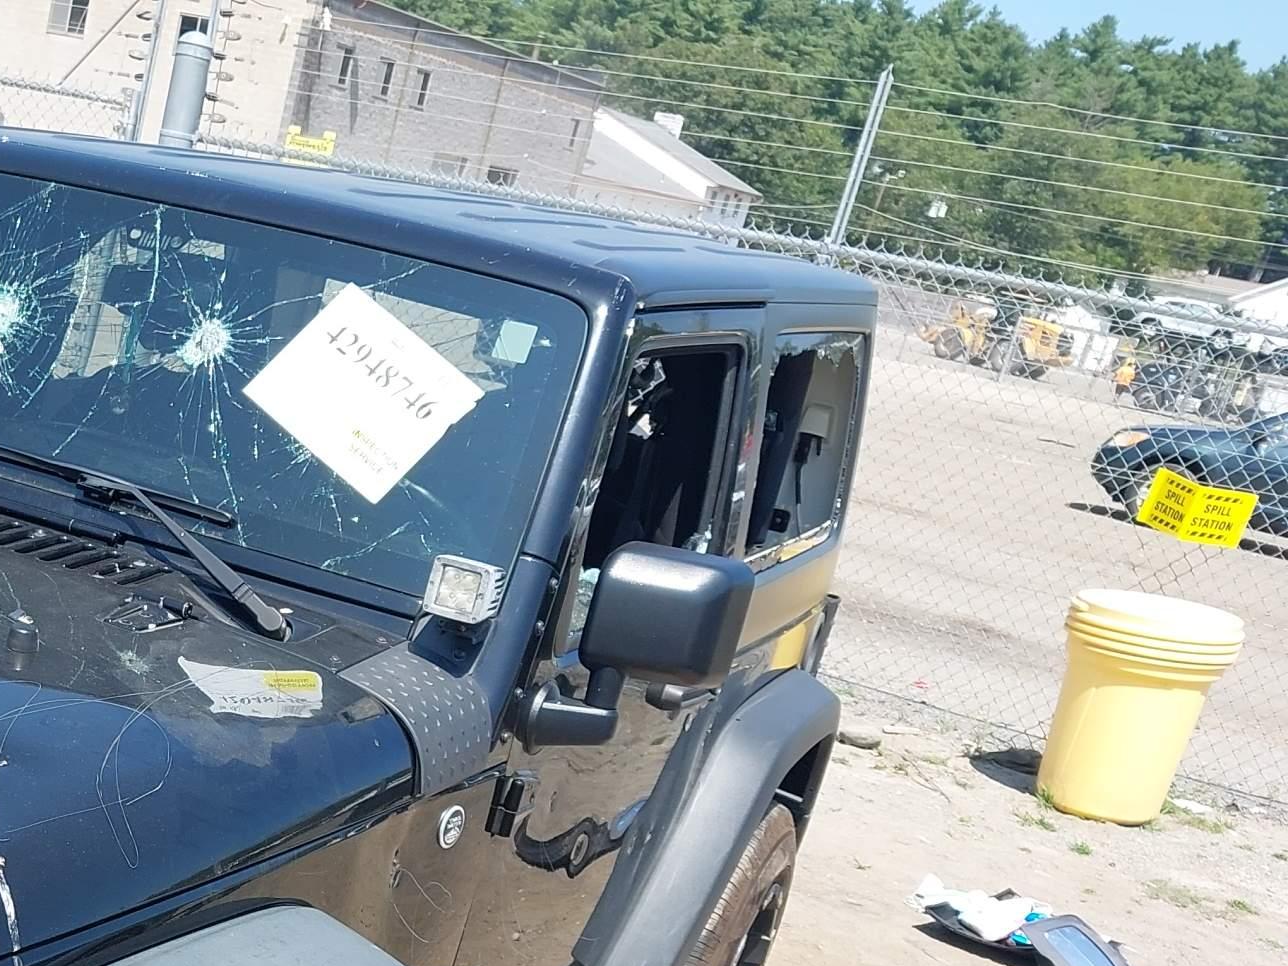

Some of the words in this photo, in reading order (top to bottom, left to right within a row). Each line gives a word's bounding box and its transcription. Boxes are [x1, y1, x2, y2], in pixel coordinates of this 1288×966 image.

[327, 326, 439, 420] 42948746
[1165, 489, 1187, 507] SPILL
[1154, 501, 1186, 523] STATION
[1203, 504, 1232, 517] SPILL
[1190, 517, 1233, 532] STATION
